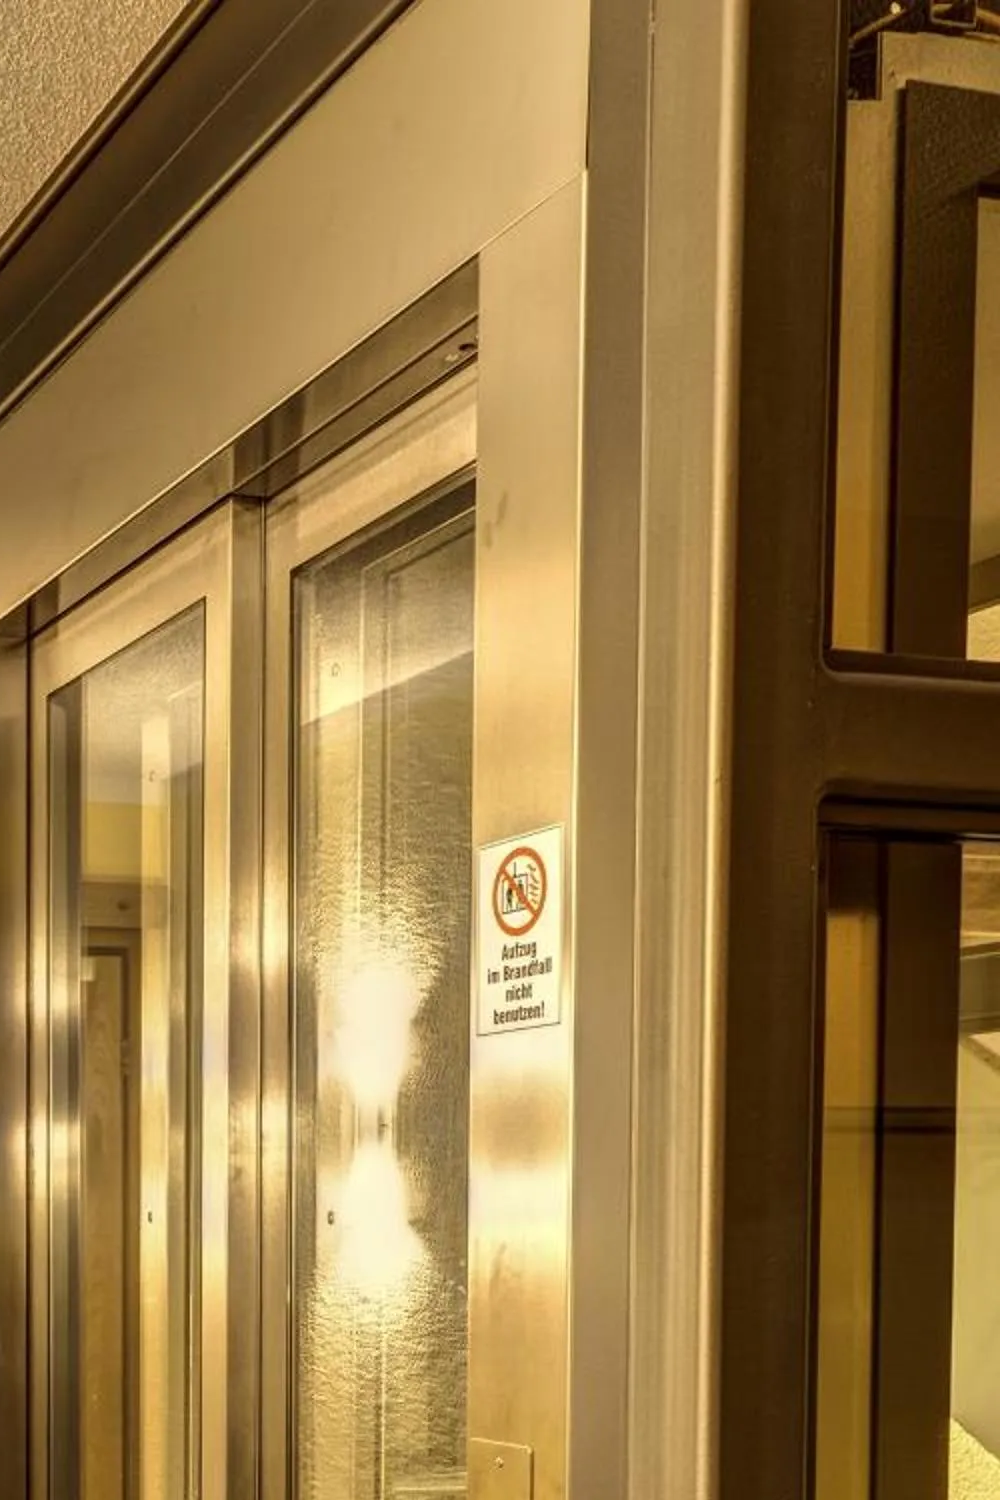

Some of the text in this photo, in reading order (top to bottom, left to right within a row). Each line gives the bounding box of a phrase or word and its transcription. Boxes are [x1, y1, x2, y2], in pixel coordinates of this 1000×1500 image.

[501, 941, 537, 961] Aufzug
[487, 956, 553, 985] im Brandfall
[505, 983, 533, 1003] nicht
[493, 1000, 545, 1025] benutzen!
